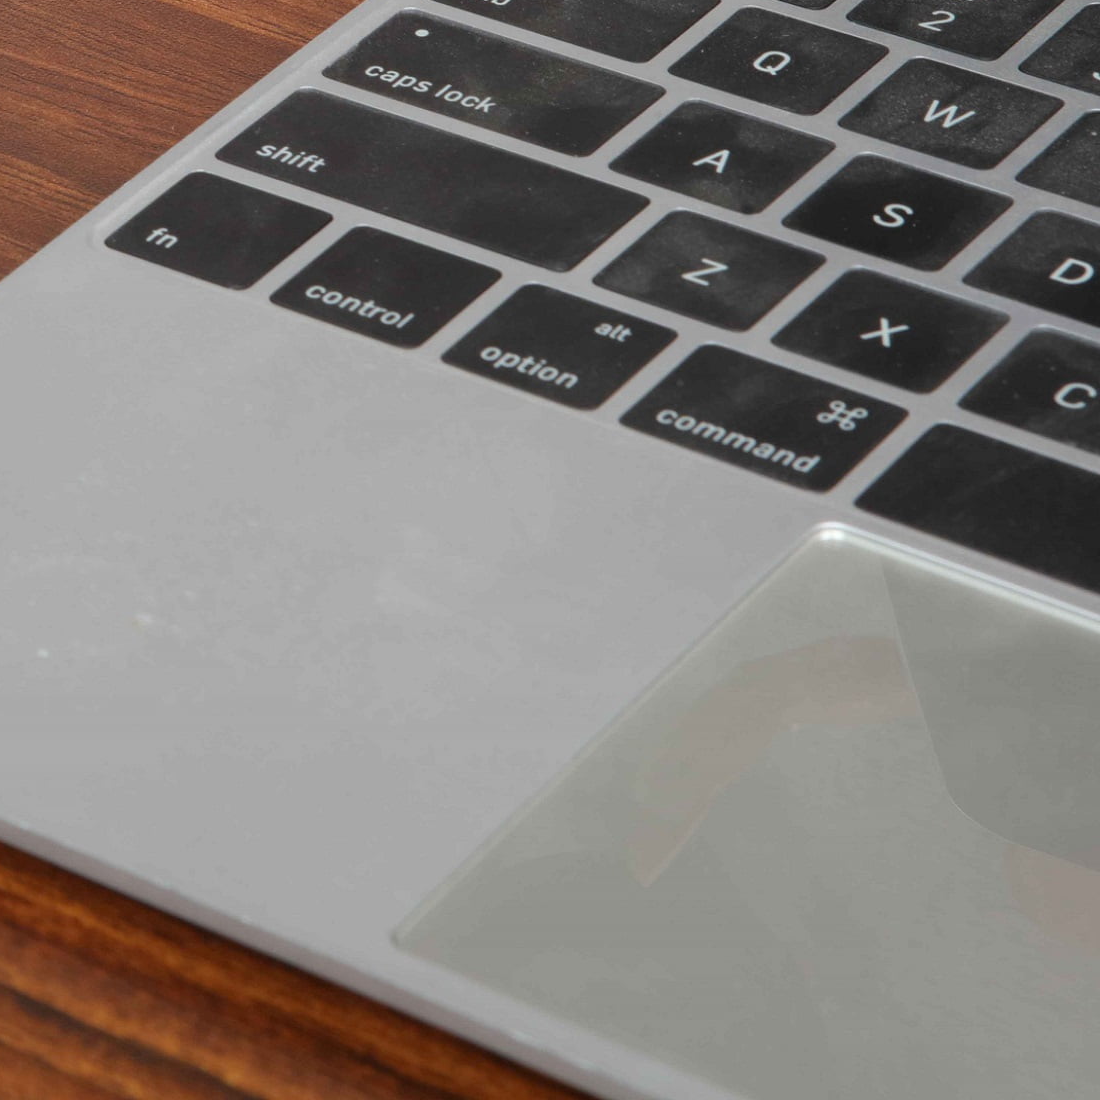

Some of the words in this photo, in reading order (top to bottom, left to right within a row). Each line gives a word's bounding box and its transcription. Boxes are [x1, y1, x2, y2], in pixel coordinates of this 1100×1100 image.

[917, 10, 956, 32] 2
[752, 50, 791, 76] Q
[364, 64, 433, 94] caps
[435, 83, 497, 114] lock
[923, 99, 976, 128] W
[255, 143, 326, 174] shift
[692, 149, 730, 174] A
[872, 203, 914, 228] S
[145, 227, 178, 249] fn
[681, 258, 728, 286] Z
[1049, 257, 1094, 285] D
[304, 284, 415, 330] control
[594, 322, 633, 343] alt
[860, 317, 909, 347] X
[480, 345, 579, 390] option
[1054, 382, 1097, 409] C
[655, 408, 821, 475] command
